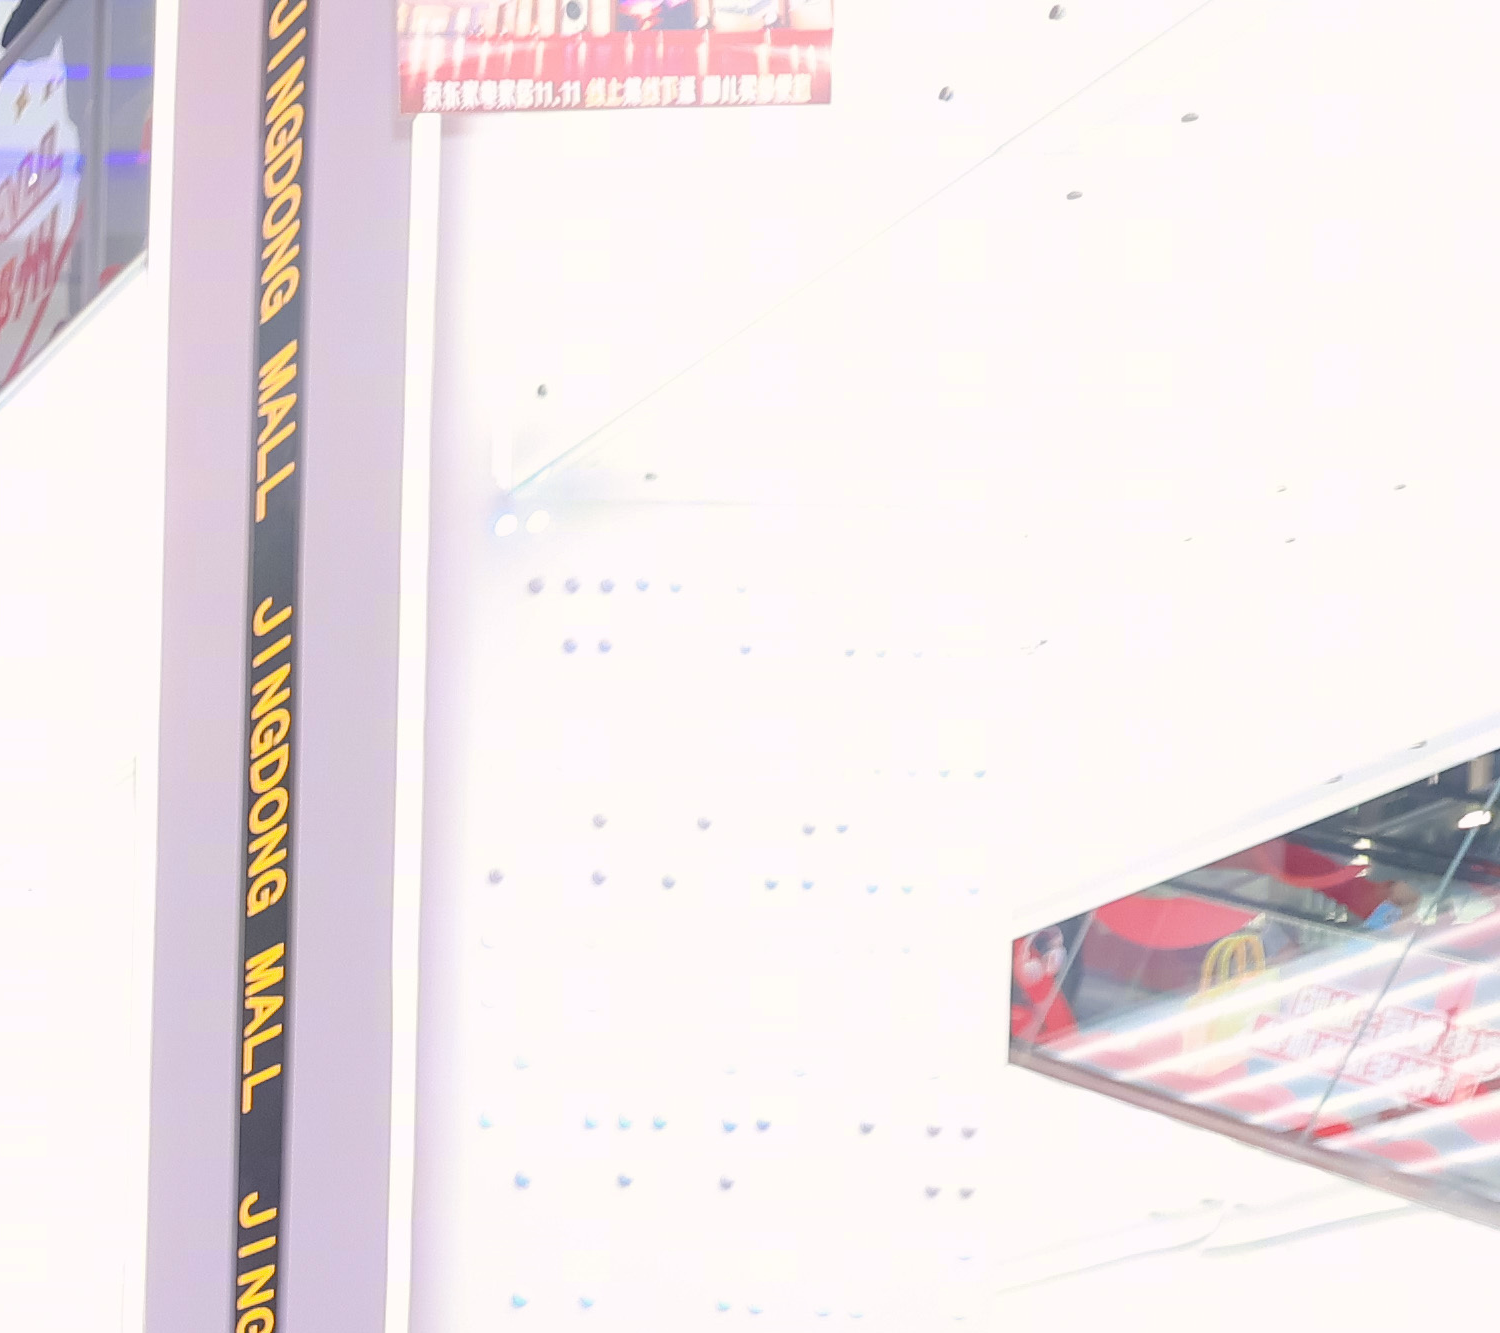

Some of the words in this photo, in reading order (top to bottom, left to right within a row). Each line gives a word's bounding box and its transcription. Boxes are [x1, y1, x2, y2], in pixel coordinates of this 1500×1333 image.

[255, 339, 297, 522] MALL
[247, 597, 292, 917] JINGDONG
[242, 942, 285, 1114] MALL
